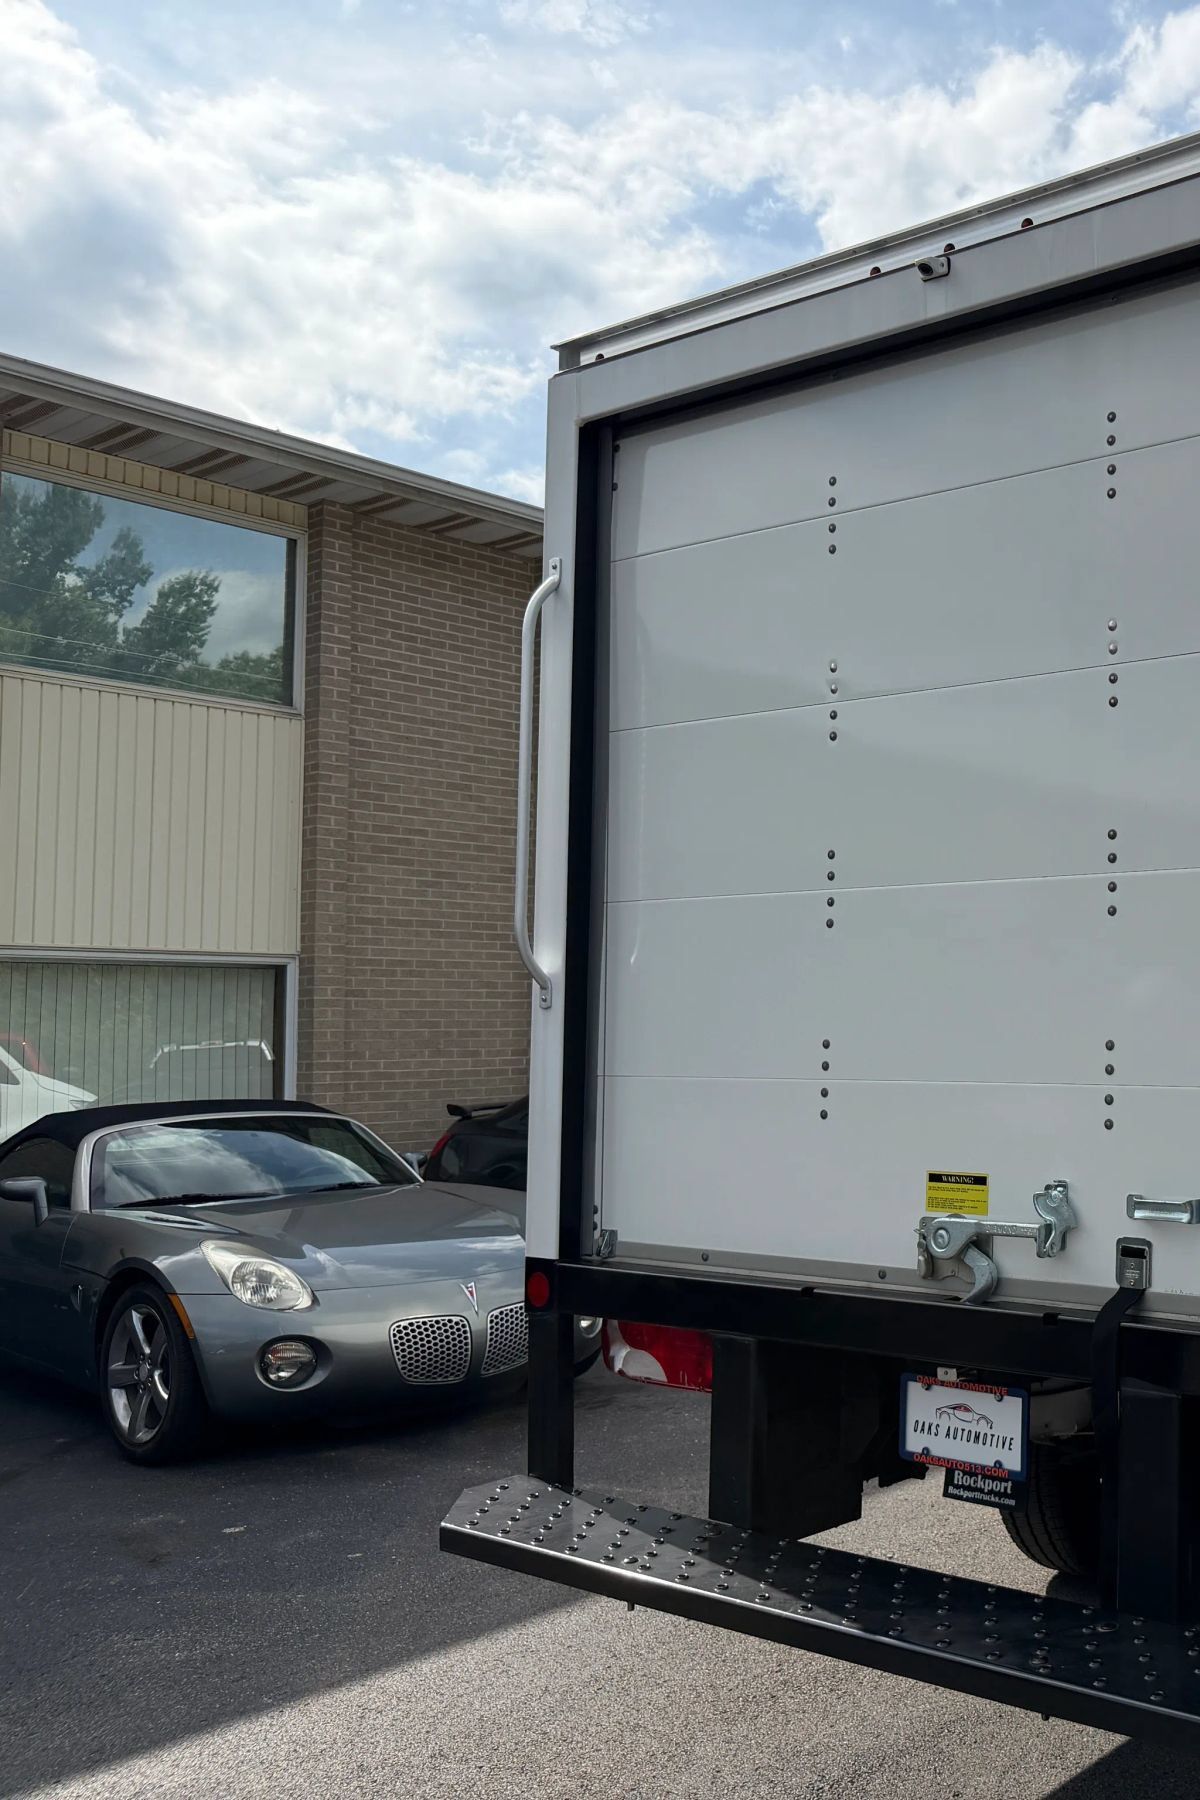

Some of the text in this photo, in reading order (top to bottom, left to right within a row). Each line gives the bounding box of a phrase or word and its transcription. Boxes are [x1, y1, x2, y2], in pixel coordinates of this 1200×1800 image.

[942, 1175, 974, 1184] WARNING!
[916, 1375, 1008, 1396] OAKS AUTOMOTIVE
[913, 1420, 1015, 1451] OAKS AUTOMOTIVE
[914, 1453, 1009, 1478] OAKSAUTO513.COM
[953, 1469, 1013, 1494] Rockport
[947, 1485, 1016, 1506] Rockporttrucks.com
